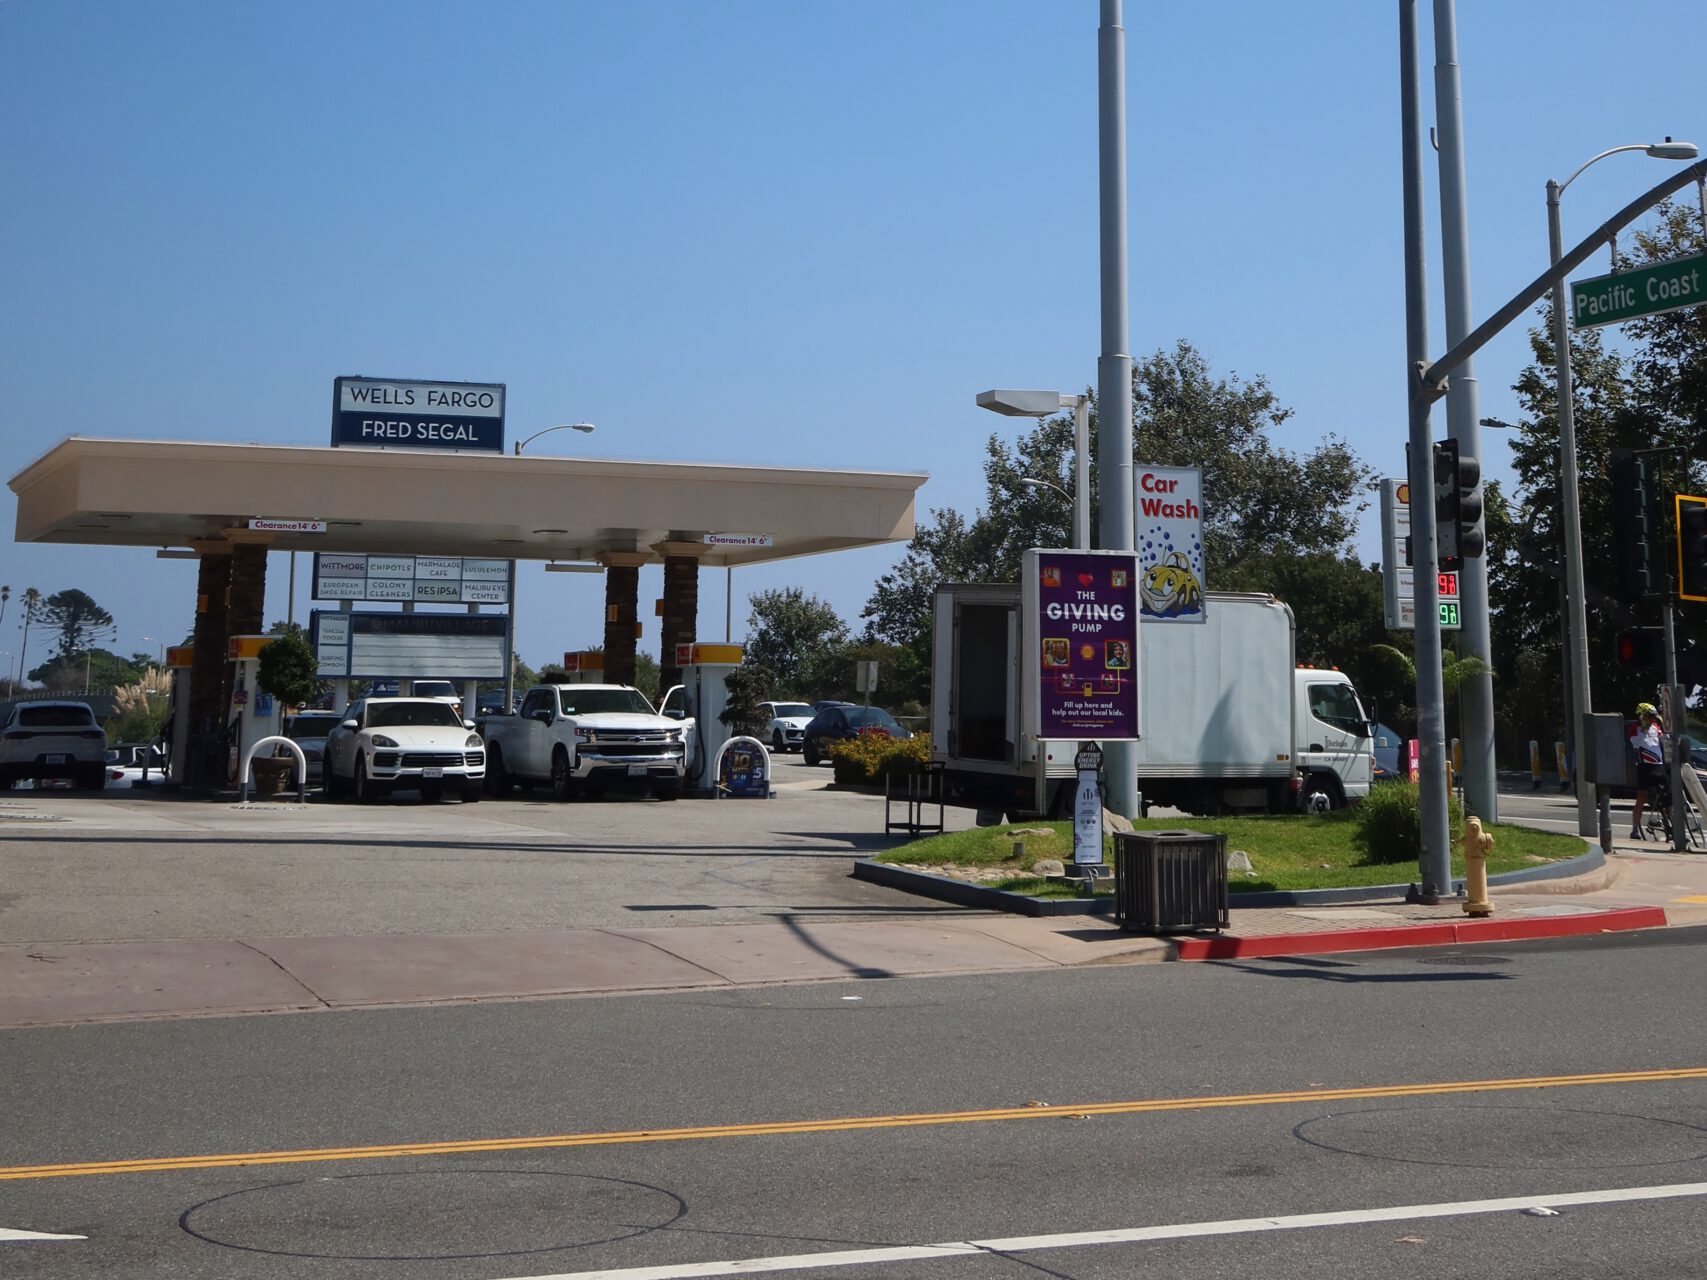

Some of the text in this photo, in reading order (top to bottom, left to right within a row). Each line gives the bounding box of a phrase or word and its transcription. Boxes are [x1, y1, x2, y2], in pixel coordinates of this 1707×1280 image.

[1576, 268, 1700, 318] Pacific Coast
[350, 387, 494, 409] WELLS FARGO
[361, 420, 479, 441] FRED SEGAL
[1141, 472, 1179, 494] Car
[1140, 497, 1200, 520] Wash
[254, 520, 297, 530] Clearance
[709, 535, 747, 545] Clearance
[320, 562, 365, 571] WITTMORE
[370, 563, 412, 572] CHIPOTLE
[417, 561, 461, 569] MARMALADE
[429, 569, 448, 577] CAFE
[372, 581, 407, 589] COLONY
[464, 584, 491, 592] MALIBU
[369, 590, 411, 598] CLEANERS
[417, 586, 458, 596] RES IPSA
[471, 592, 499, 600] CENTER
[1076, 590, 1096, 601] THE
[1046, 602, 1126, 622] GIVING
[1071, 622, 1103, 633] PUMP
[1100, 701, 1113, 709] and
[1051, 708, 1067, 717] help
[1092, 708, 1108, 716] local
